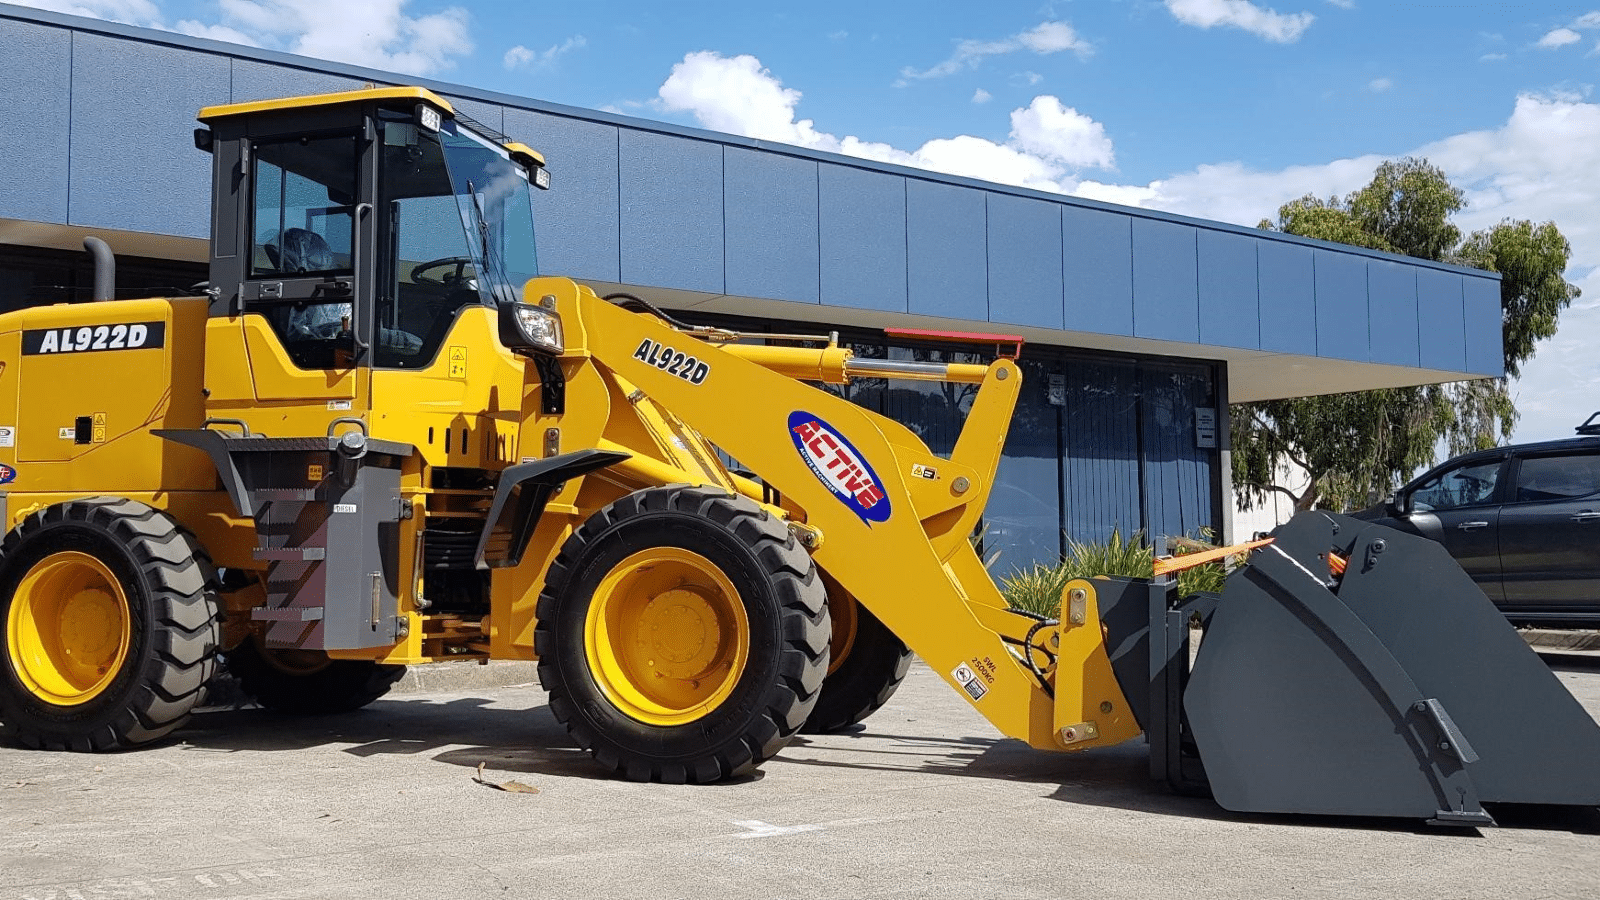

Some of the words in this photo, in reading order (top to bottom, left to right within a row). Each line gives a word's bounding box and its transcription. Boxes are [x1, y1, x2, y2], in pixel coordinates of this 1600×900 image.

[39, 324, 148, 354] AL922D
[632, 337, 711, 386] AL922D
[792, 420, 885, 510] ACTIVE
[971, 656, 995, 684] 2500KG
[983, 656, 996, 673] SWL
